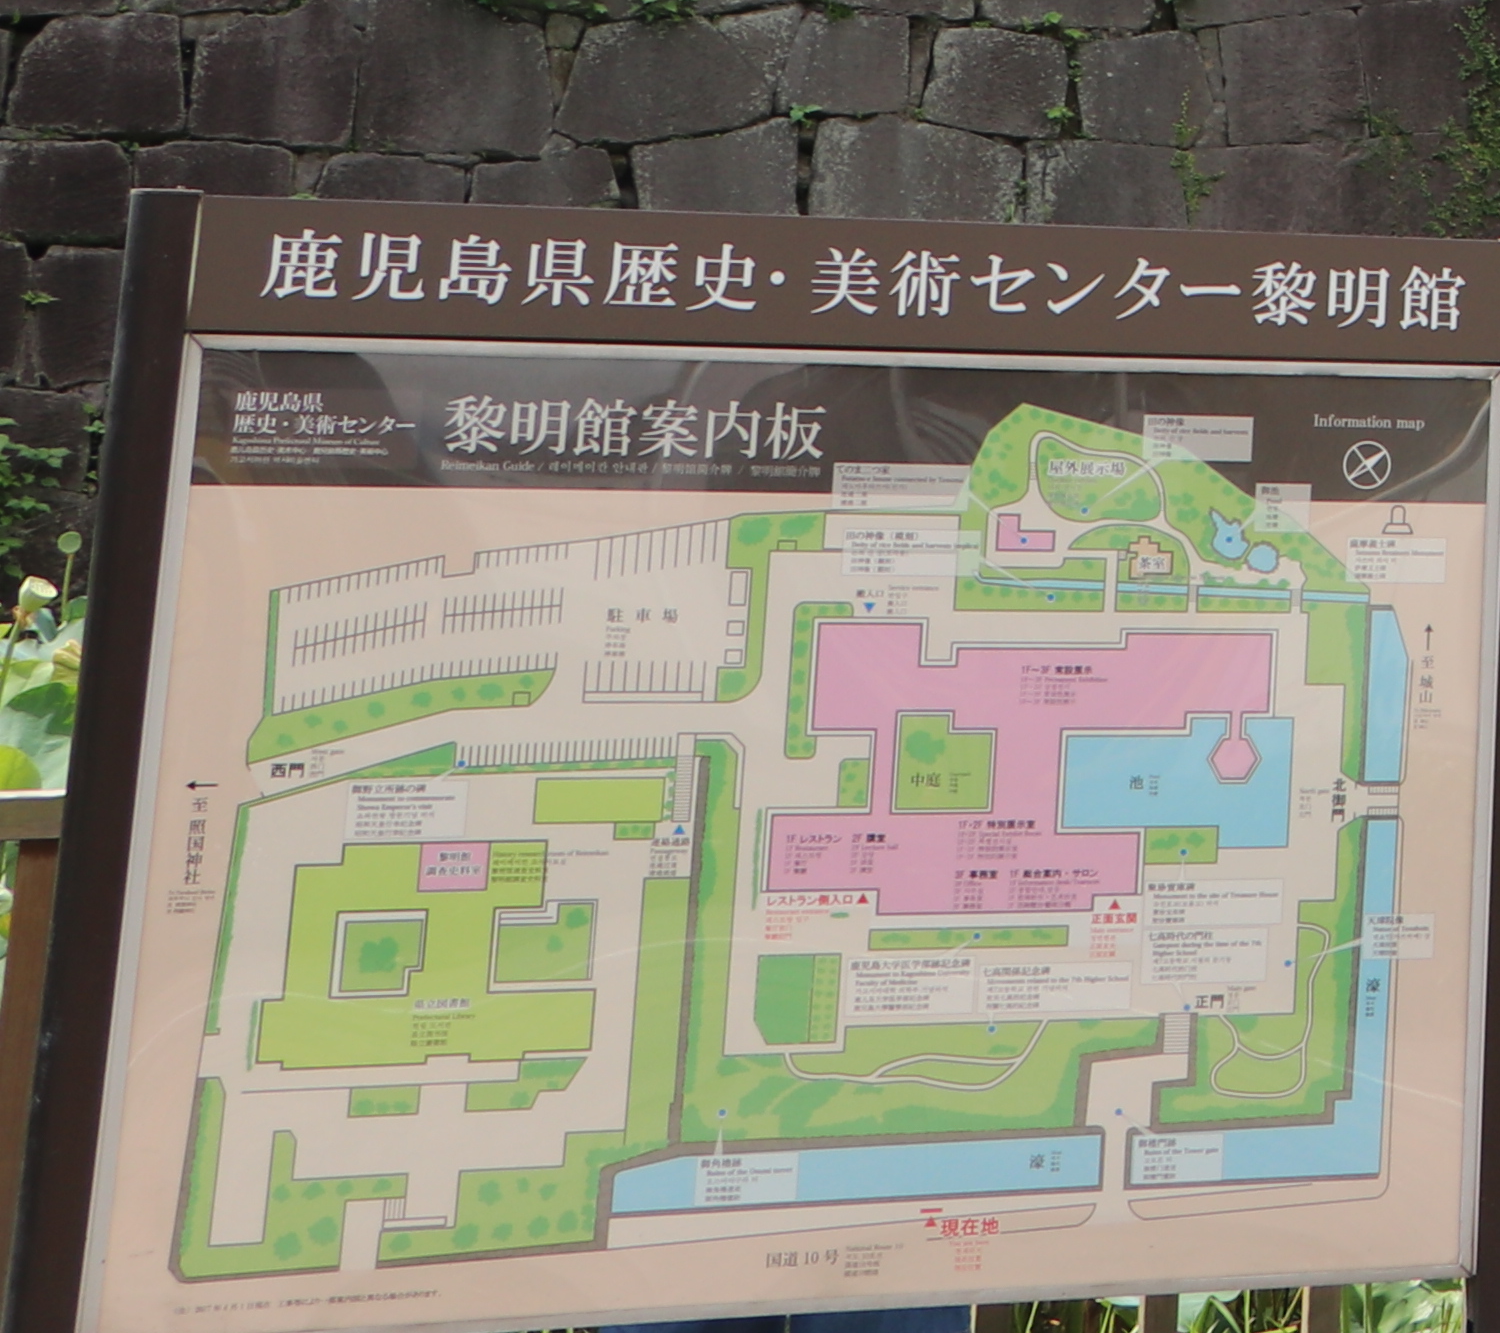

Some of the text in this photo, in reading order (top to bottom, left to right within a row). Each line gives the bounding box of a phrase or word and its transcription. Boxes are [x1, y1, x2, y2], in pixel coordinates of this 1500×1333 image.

[260, 228, 1466, 331] 鹿児島県歴史・美術センター黎明館
[234, 391, 324, 413] 鹿児島県
[233, 413, 416, 435] 歴史・美術センター
[444, 394, 827, 460] 黎明館案内板
[1314, 414, 1425, 432] Information map
[440, 459, 499, 471] Reimeikan
[502, 460, 535, 471] Guide
[1049, 460, 1125, 475] 屋外展示場
[1139, 556, 1166, 570] 茶室
[606, 607, 679, 624] 駐車場
[1421, 655, 1435, 669] 至
[1419, 674, 1434, 704] 城山
[271, 763, 305, 779] 西門
[911, 772, 941, 788] 中庭
[1129, 775, 1145, 790] 池
[1332, 777, 1347, 823] 北御門
[184, 797, 208, 886] 至 照国神社
[800, 834, 842, 844] レストラン
[767, 894, 853, 906] レストラン側入口
[1091, 912, 1137, 924] 正面玄関
[1194, 994, 1225, 1009] 正門
[940, 1217, 1000, 1237] 現在地
